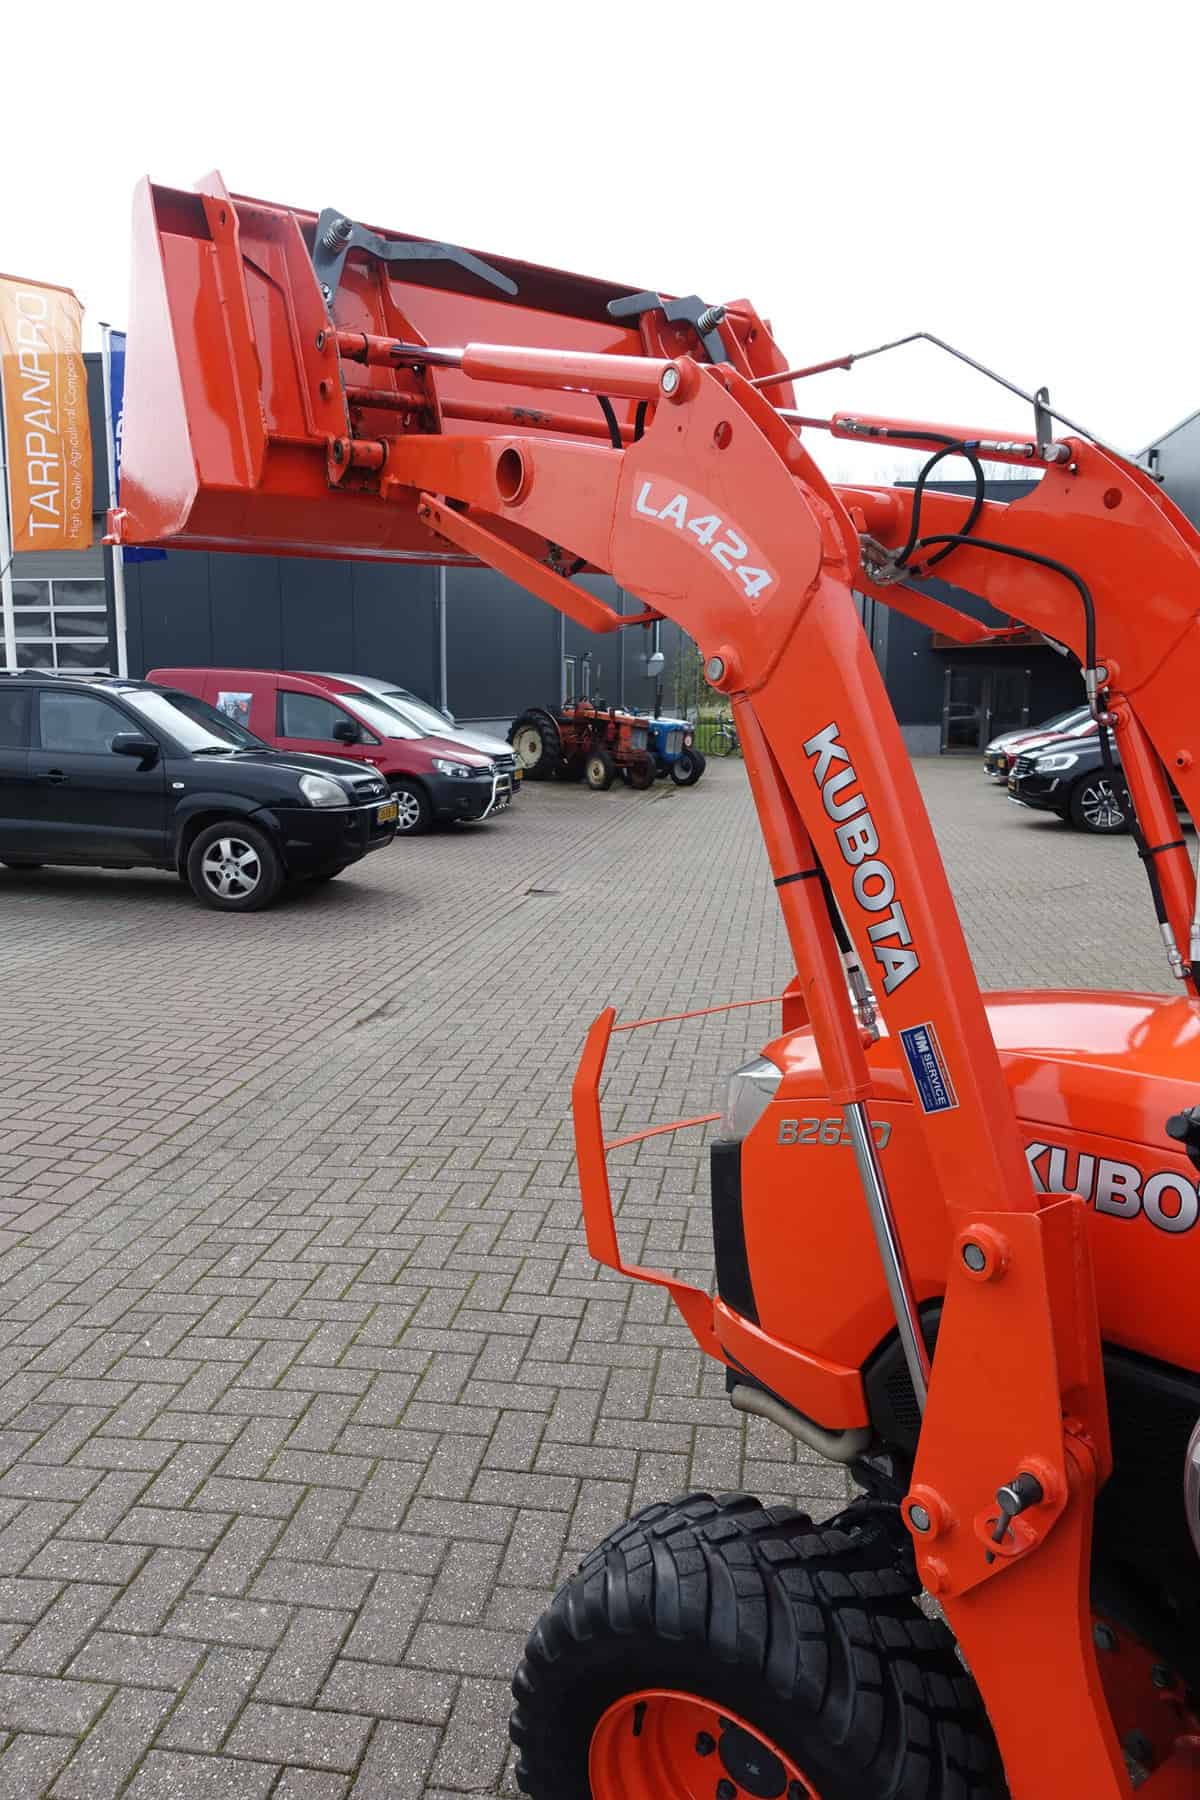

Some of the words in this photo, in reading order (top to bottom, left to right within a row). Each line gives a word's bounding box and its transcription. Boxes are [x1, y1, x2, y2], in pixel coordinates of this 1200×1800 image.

[15, 291, 60, 537] TARPANPRO
[69, 513, 83, 538] High
[70, 470, 83, 510] Quality
[636, 481, 773, 598] LA424
[802, 721, 921, 997] KUBOTA
[923, 1053, 947, 1105] SERVICE
[1024, 1142, 1200, 1233] KUBO
